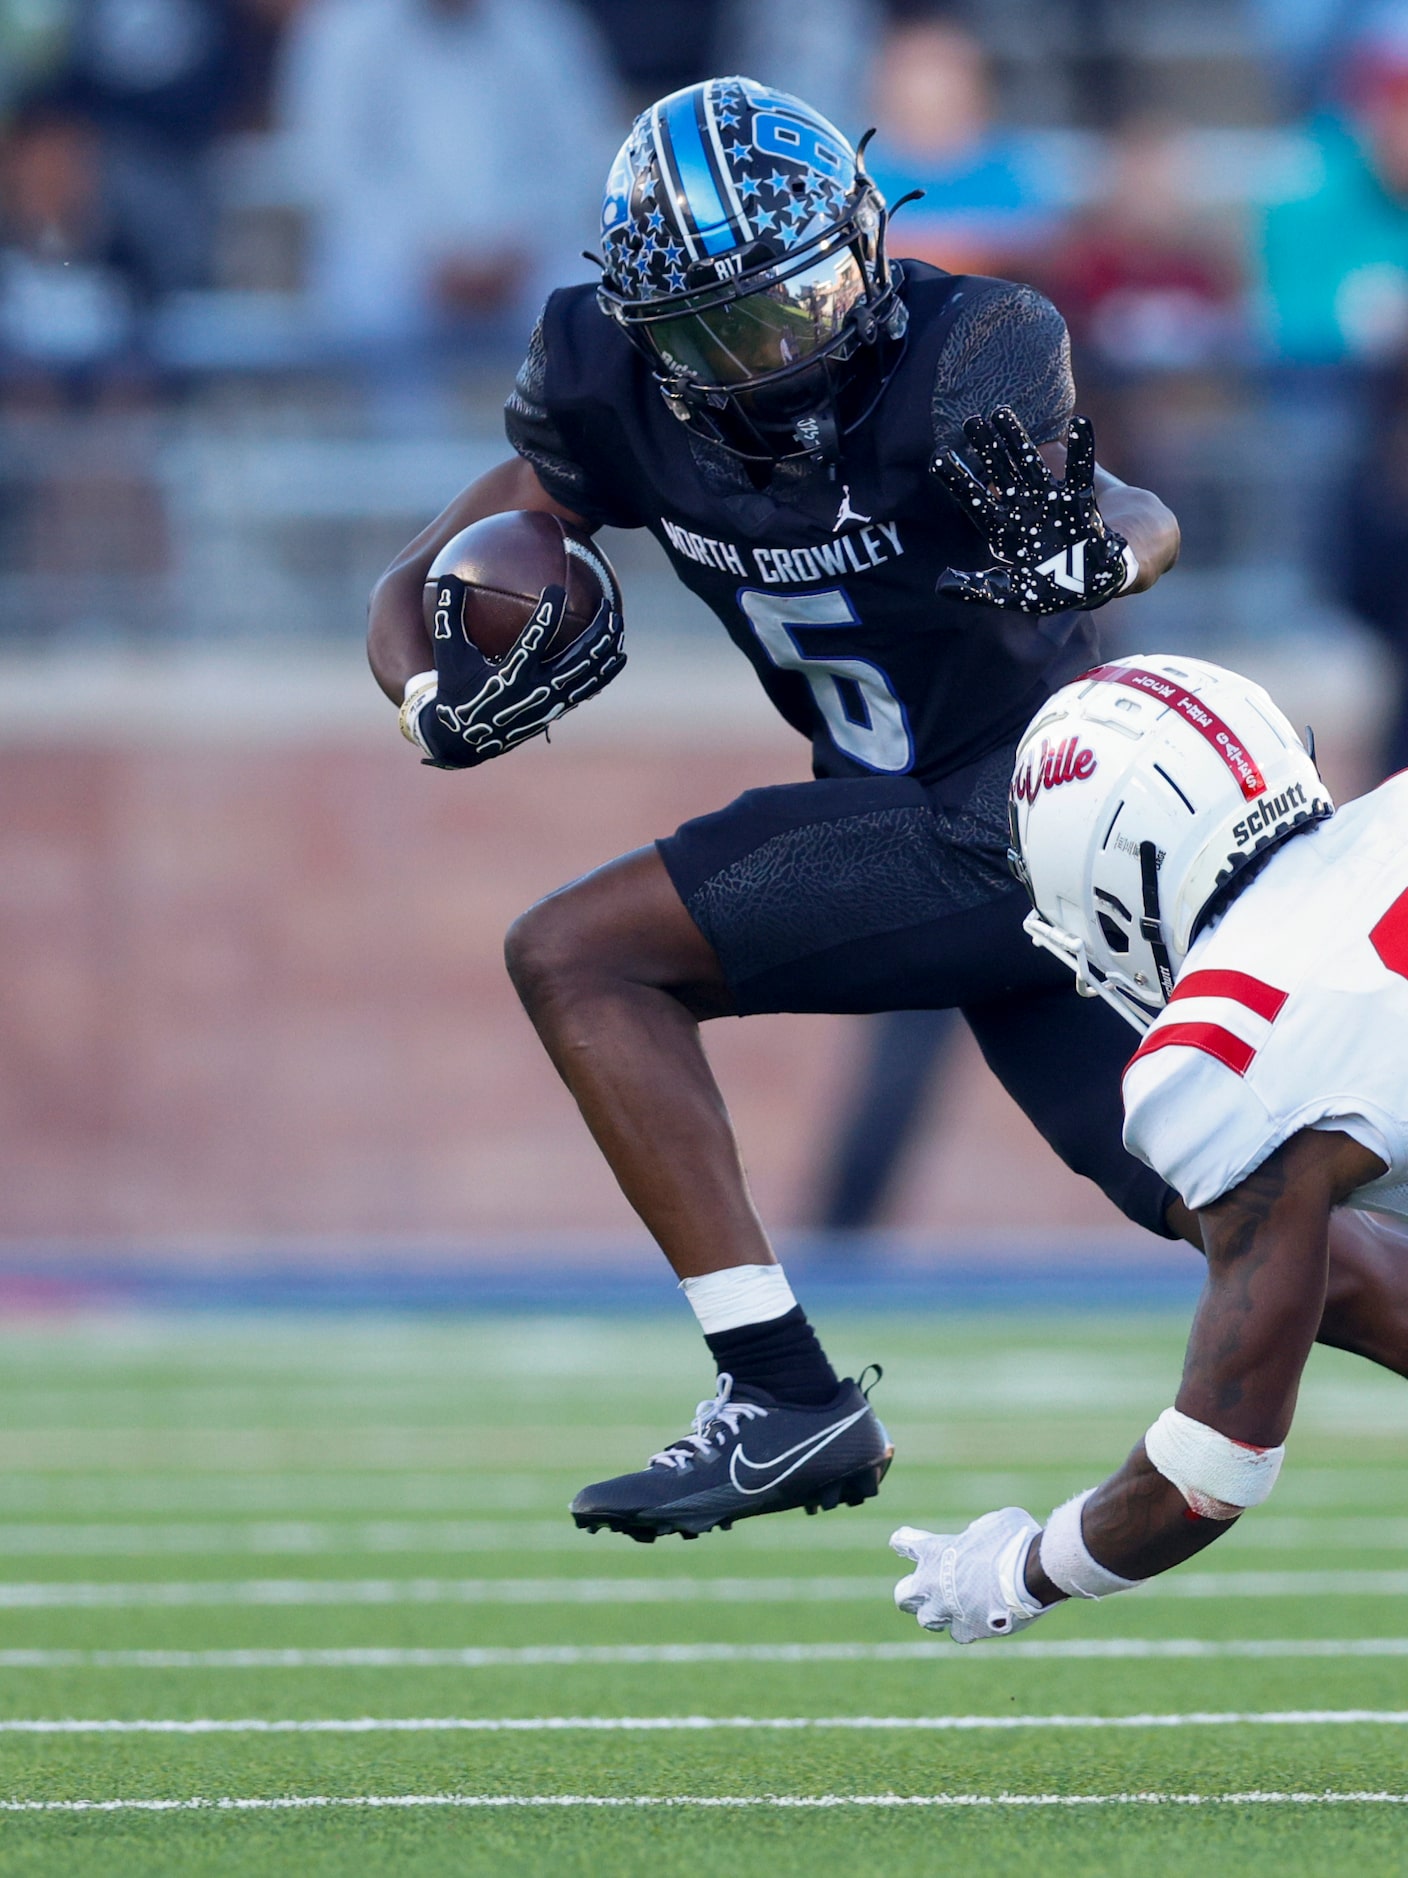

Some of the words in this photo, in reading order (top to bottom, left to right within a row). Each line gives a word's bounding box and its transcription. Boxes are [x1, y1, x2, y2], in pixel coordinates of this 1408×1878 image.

[714, 254, 743, 281] 817
[661, 517, 749, 578] NORTH
[752, 521, 905, 584] CROWLEY
[735, 585, 915, 776] 6
[1177, 697, 1213, 728] THE
[1216, 732, 1257, 789] GATES
[1232, 781, 1307, 846] schutt
